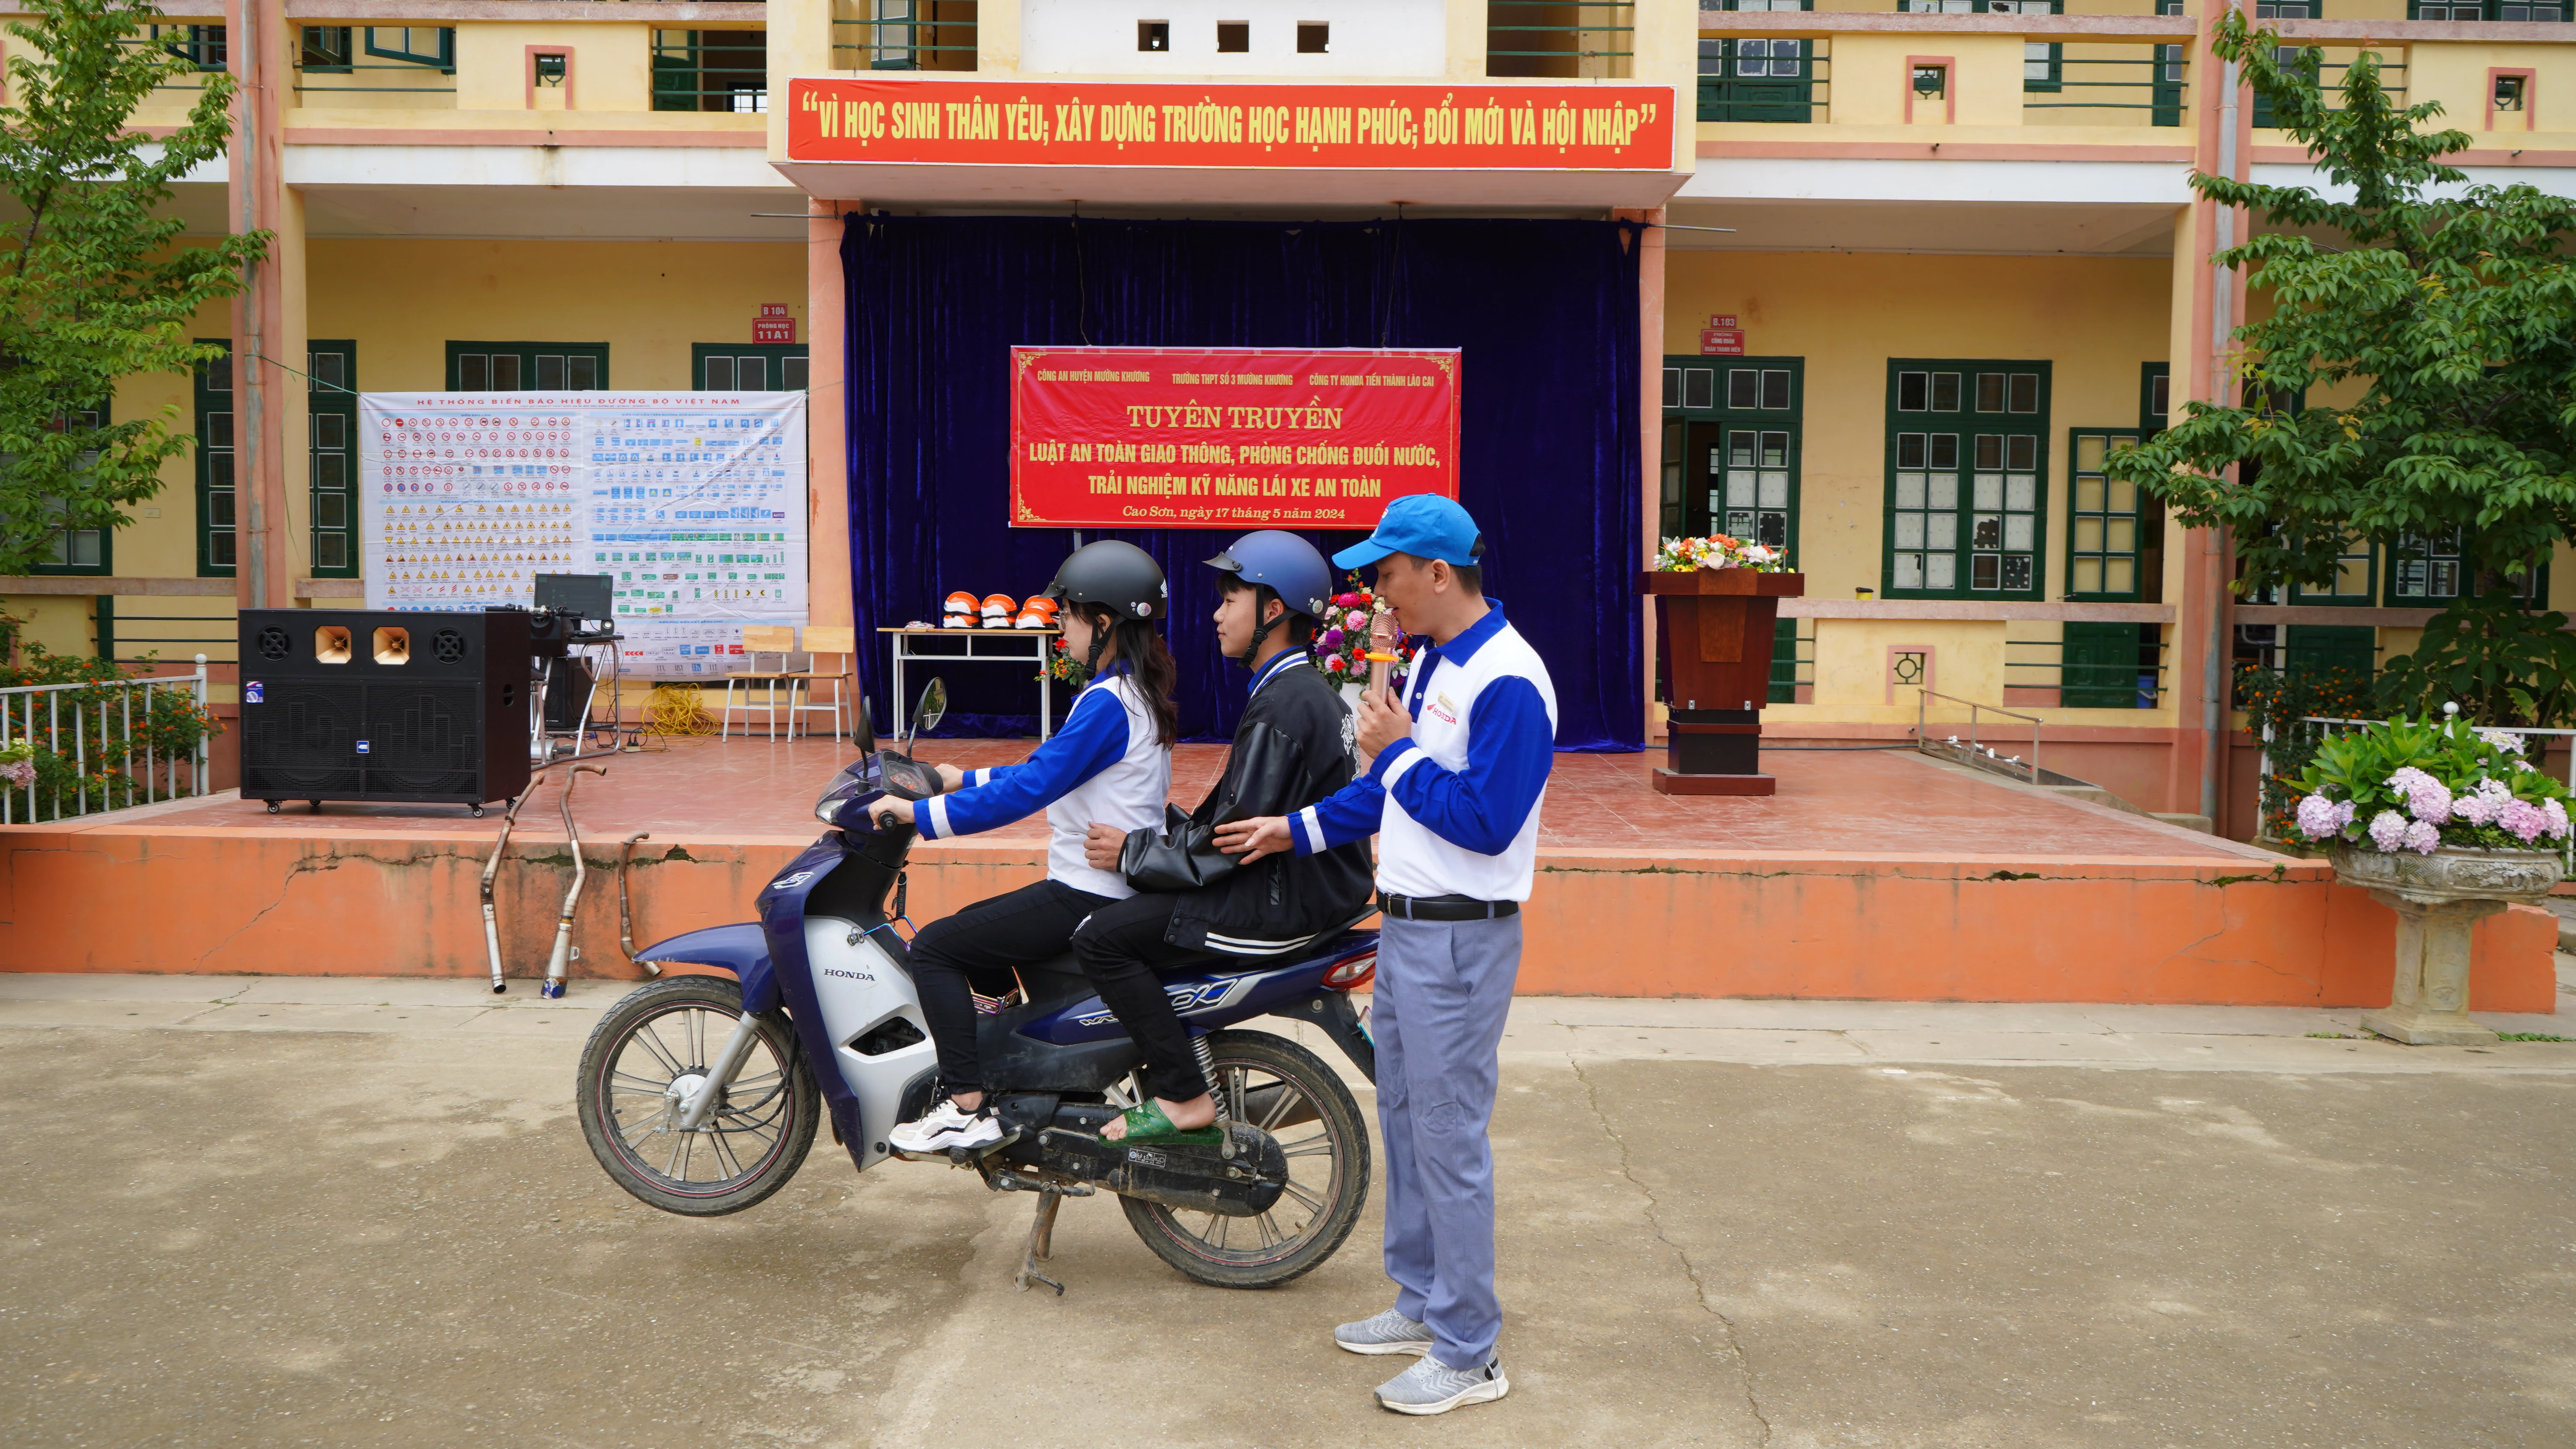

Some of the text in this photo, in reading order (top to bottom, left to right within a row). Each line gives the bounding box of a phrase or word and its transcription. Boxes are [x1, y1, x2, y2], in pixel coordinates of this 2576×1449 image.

[845, 101, 884, 146] HỌC
[891, 102, 939, 139] SINH
[946, 95, 999, 139] THÂN
[1005, 96, 1048, 146] YÊU;
[1055, 97, 1095, 141] XÂY
[1101, 101, 1155, 149] DỰNG
[1162, 96, 1242, 143] TRƯỜNG
[1249, 106, 1289, 151] HỌC
[1296, 107, 1351, 152] HẠNH
[1358, 100, 1418, 149] PHÚC;
[1424, 93, 1458, 145] ĐỔI
[1465, 97, 1504, 145] MỚI
[1510, 100, 1536, 145] VÀ
[1543, 100, 1576, 153] HỘI
[763, 306, 769, 315] B
[1713, 318, 1735, 326] B.103
[758, 330, 788, 339] 11A1
[1038, 369, 1149, 383] CÔNG AN HUYỆN MƯỜNG KHƯƠNG
[1172, 371, 1293, 385] TRƯỜNG THPT SỐ 3 MƯỜNG KHƯƠNG
[1309, 373, 1434, 386] CÔNG TY HONDA TIẾN THÀNH LÀO CAI
[1127, 395, 1343, 429] TUYÊN TRUYỀN
[1030, 440, 1440, 468] LUẬT AN TOÀN GIAO THÔNG, PHÒNG CHỐNG ĐUỐI NƯỚC,
[1088, 470, 1380, 499] TRẢI NGHIỆM KỸ NĂNG LÁI XE AN TOÀN
[1123, 506, 1345, 521] Cao Sơn, ngày 17 tháng 5 năm 2024
[1432, 708, 1456, 724] HONDA
[823, 968, 876, 981] HONDA
